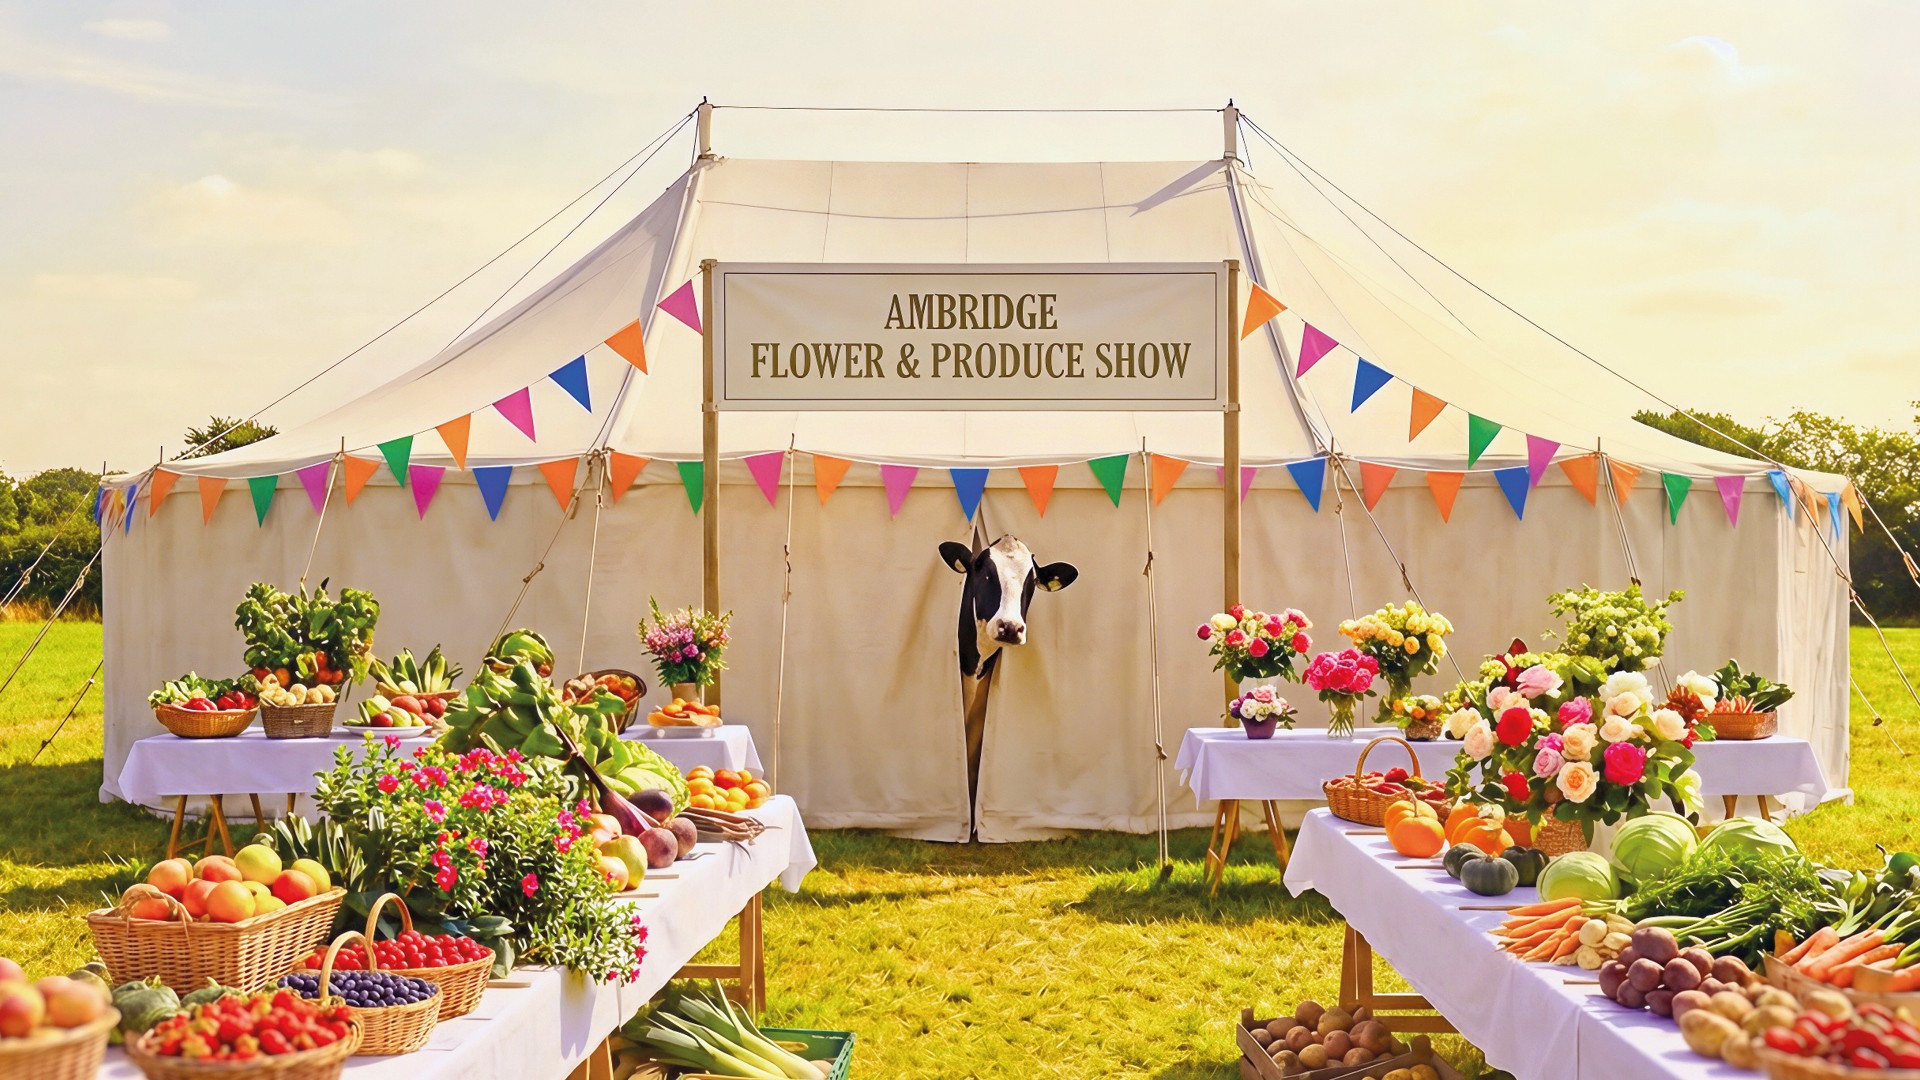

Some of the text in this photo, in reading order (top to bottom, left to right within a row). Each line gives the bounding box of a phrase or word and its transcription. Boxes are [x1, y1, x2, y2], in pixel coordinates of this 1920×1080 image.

[884, 293, 1058, 330] AMBRIDGE
[750, 342, 1192, 379] FLOWER & PRODUCE SHOW
